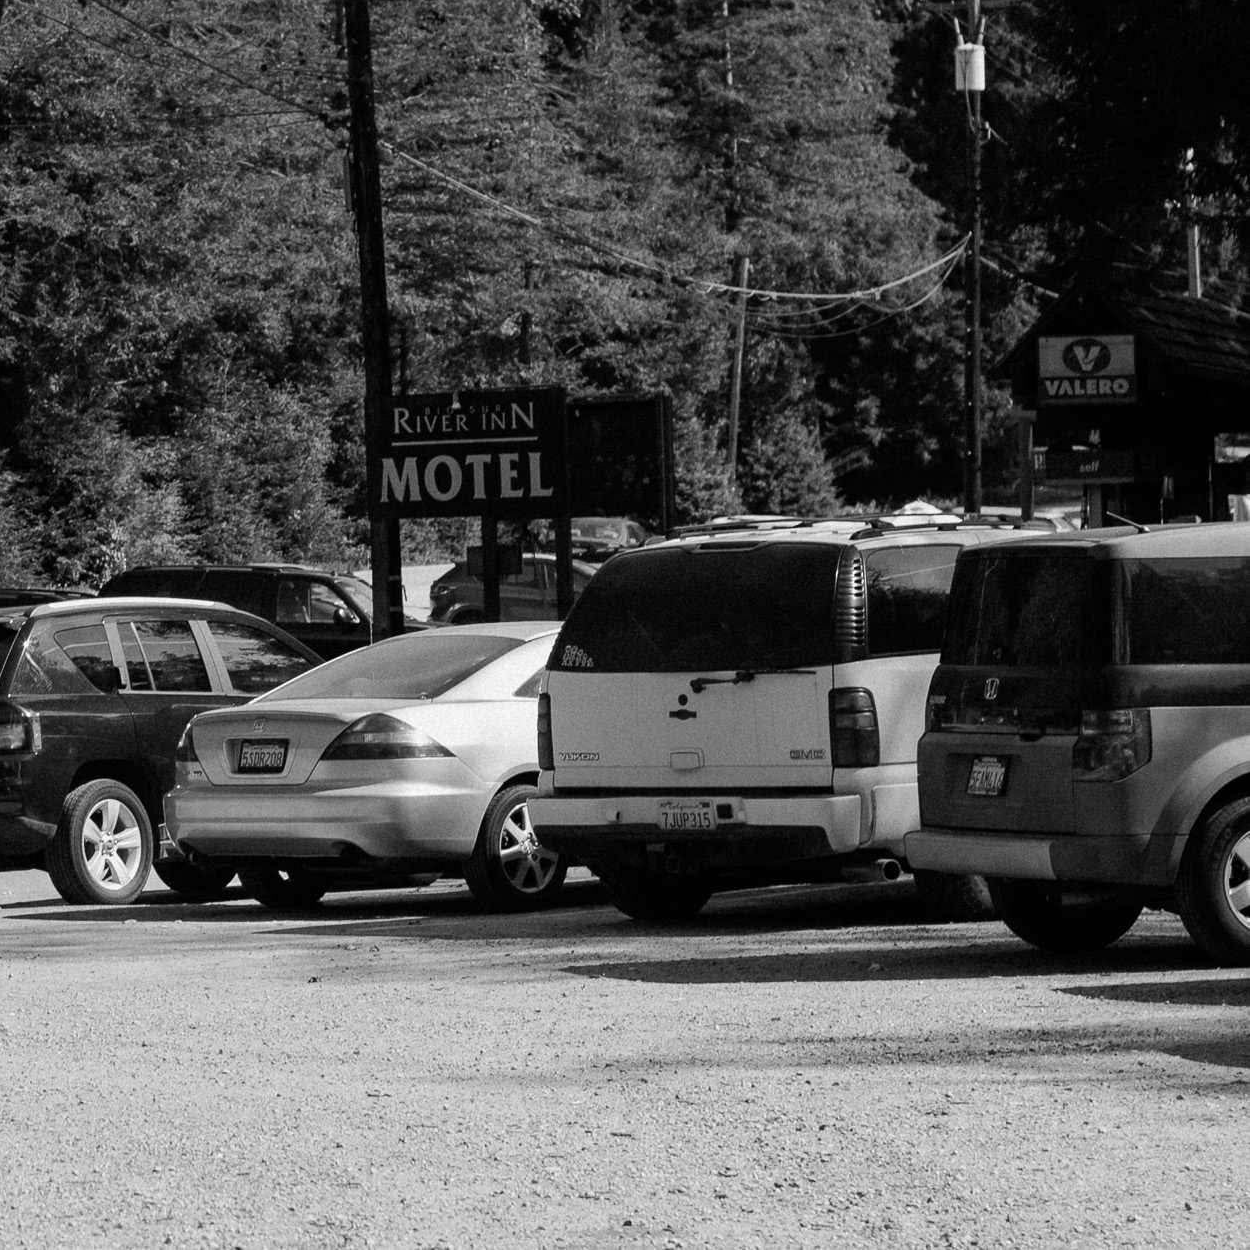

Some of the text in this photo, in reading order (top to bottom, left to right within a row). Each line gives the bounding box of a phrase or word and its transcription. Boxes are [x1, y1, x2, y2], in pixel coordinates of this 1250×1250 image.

[1044, 377, 1130, 396] VALERO
[393, 401, 535, 434] RIVER INN
[469, 404, 502, 414] SUR
[1079, 460, 1100, 473] self
[379, 451, 555, 503] MOTEL
[241, 751, 283, 768] 5SDR208
[558, 752, 600, 761] YUKON
[789, 749, 826, 760] GMC
[660, 811, 711, 829] 7JUP315
